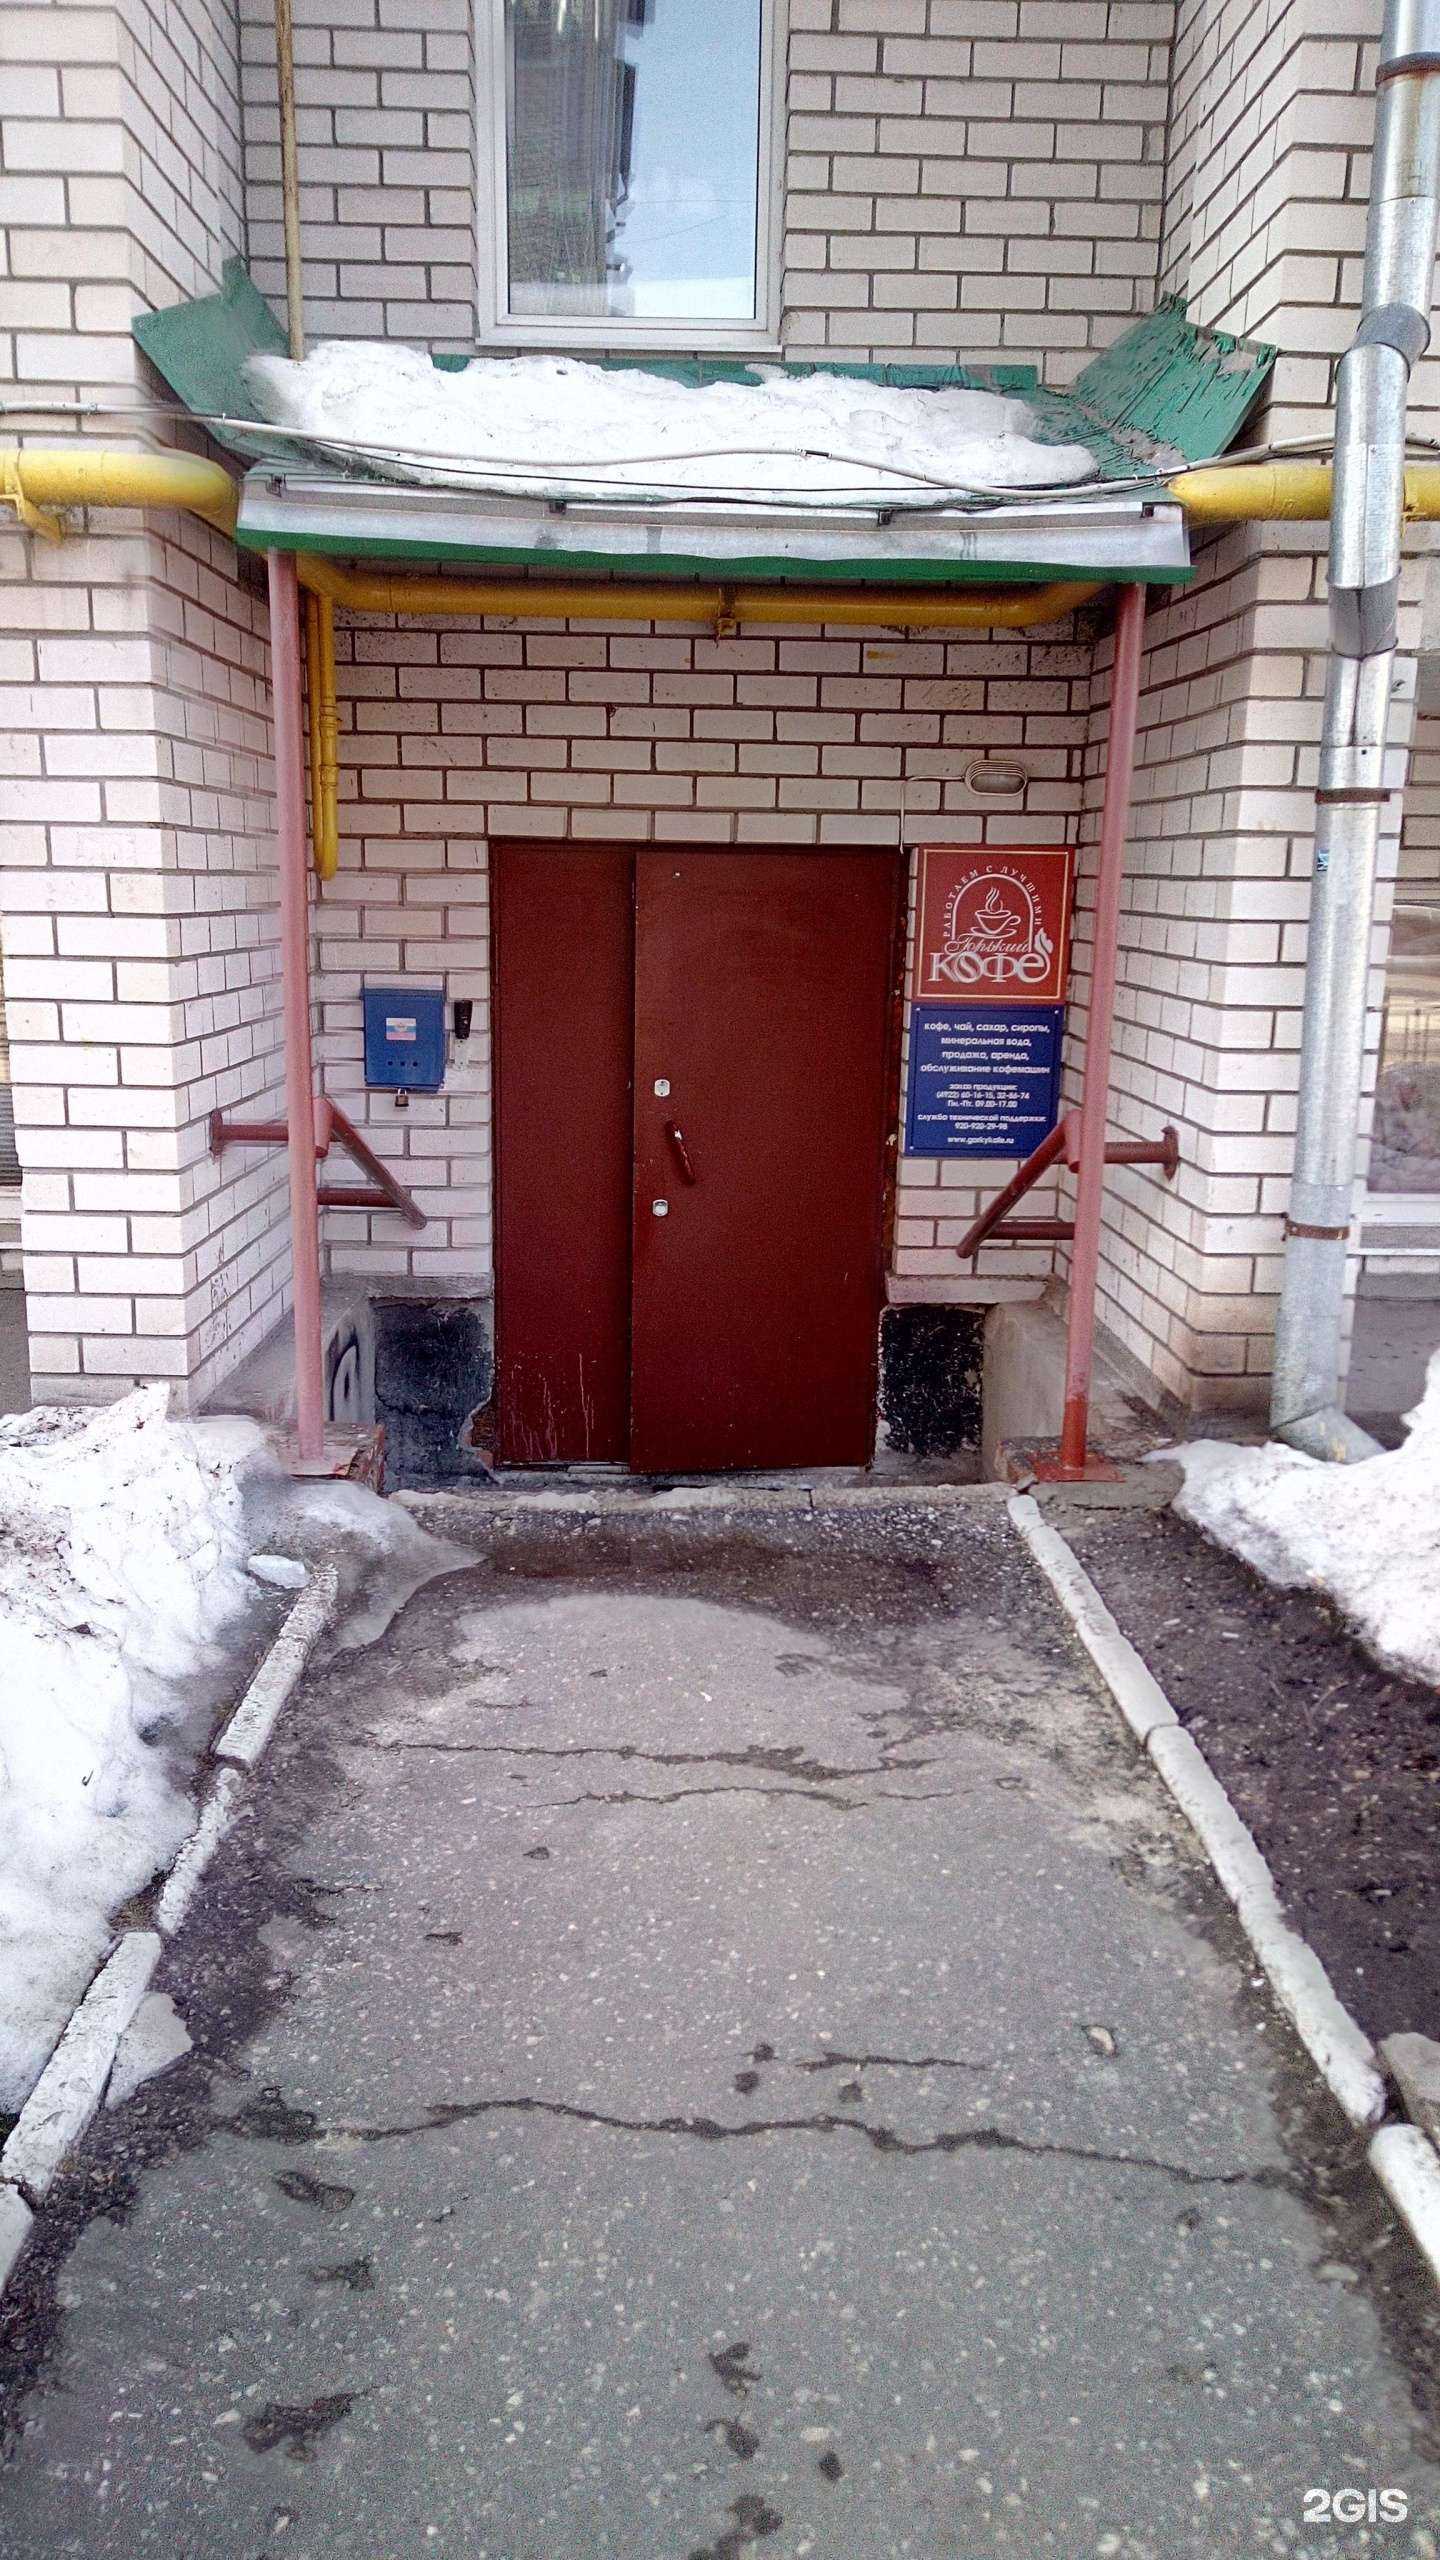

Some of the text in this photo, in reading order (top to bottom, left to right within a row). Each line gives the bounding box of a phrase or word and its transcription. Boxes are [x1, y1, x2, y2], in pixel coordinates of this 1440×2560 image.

[943, 869, 979, 937] РАБОТАЕМ
[1000, 866, 1043, 925] ЛУЧШИМИ
[924, 1022, 1050, 1034] кофе, чай, сахар, сиропы,
[941, 1037, 1032, 1047] минеральная вода,
[942, 1051, 1029, 1061] продажа, аренда,
[920, 1063, 1050, 1074] обслуживание кофемашин
[917, 1113, 947, 1122] служба
[949, 1113, 999, 1122] технической
